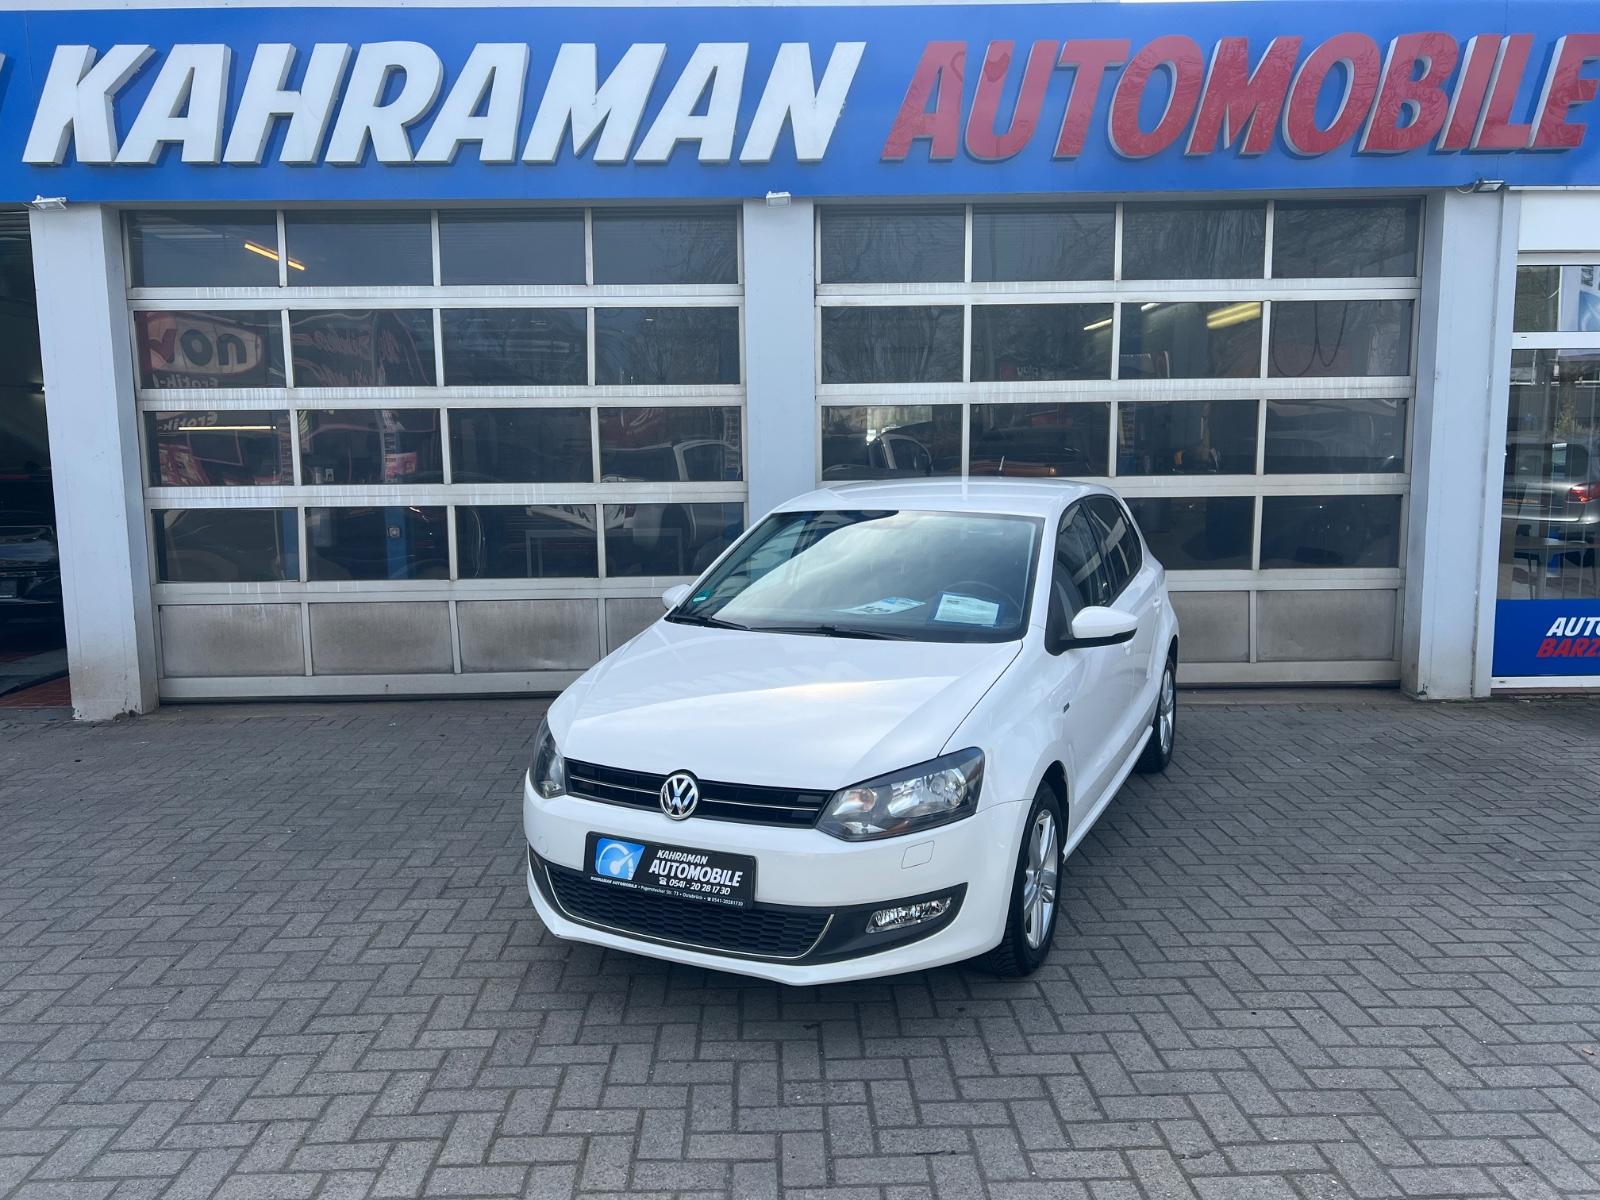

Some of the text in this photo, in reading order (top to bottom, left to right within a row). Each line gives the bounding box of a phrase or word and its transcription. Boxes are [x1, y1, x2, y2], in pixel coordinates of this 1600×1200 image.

[22, 32, 1600, 165] KAHRAMAN AUTOMOBILE
[1546, 616, 1600, 637] AUT
[656, 849, 708, 865] KAHRAMAN
[648, 859, 743, 887] AUTOMOBILE
[668, 878, 686, 889] 0541
[690, 882, 701, 891] 20
[701, 883, 711, 892] 28
[720, 887, 731, 895] 30
